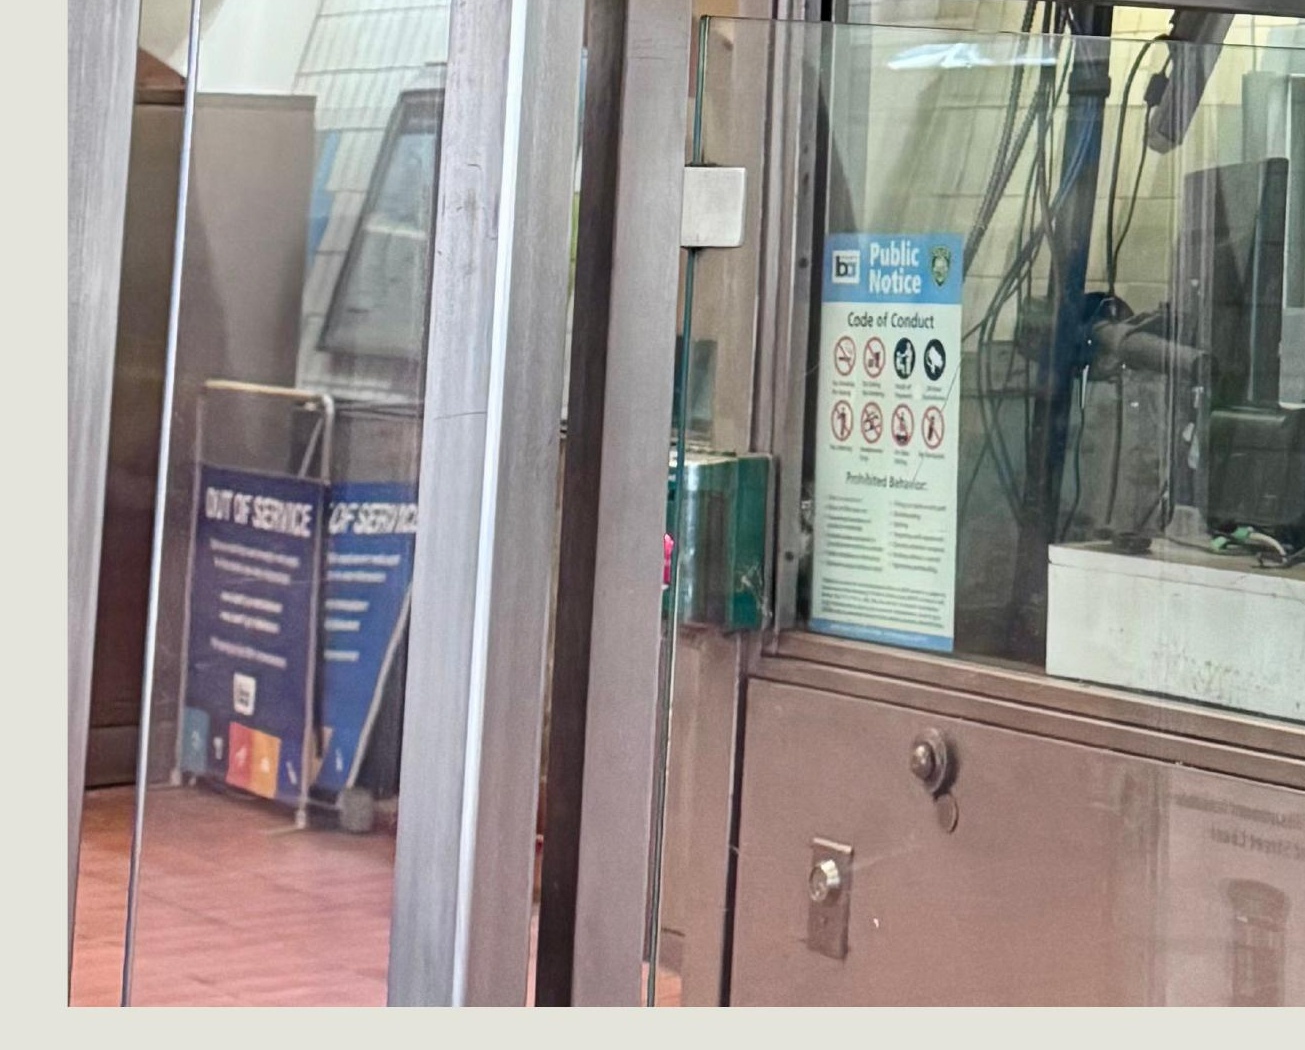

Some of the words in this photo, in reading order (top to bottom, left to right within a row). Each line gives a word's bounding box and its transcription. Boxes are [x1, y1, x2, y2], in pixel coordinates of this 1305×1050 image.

[869, 240, 920, 268] Public
[868, 267, 922, 295] Notice
[847, 311, 874, 328] Code
[876, 312, 888, 328] of
[891, 312, 935, 330] Conduct
[846, 471, 888, 488] Prohibited
[205, 486, 234, 521] OUT
[233, 491, 253, 525] OF
[252, 496, 313, 538] SERVICE
[328, 502, 358, 535] OF
[353, 501, 420, 535] SERVIC
